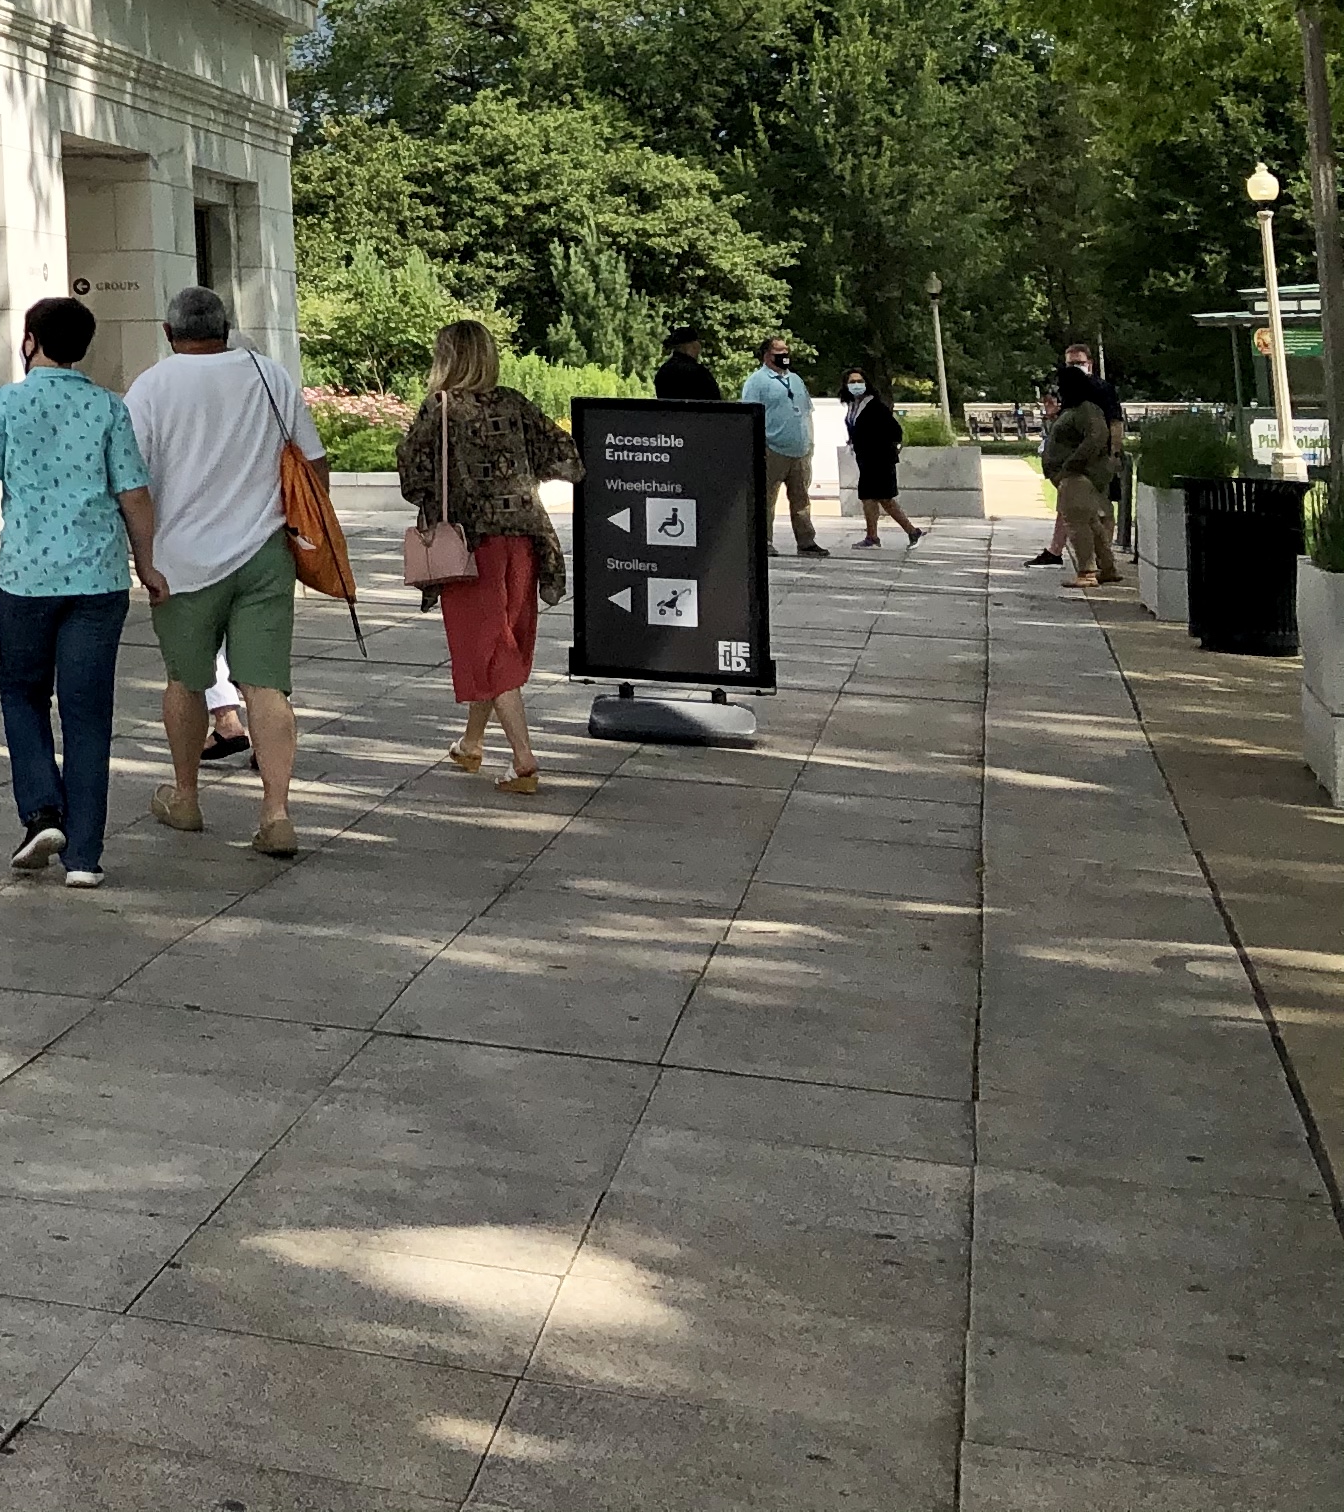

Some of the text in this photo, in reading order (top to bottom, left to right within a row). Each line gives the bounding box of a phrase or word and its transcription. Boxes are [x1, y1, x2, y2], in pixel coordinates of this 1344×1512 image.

[95, 281, 140, 291] GROUPS
[605, 433, 684, 448] Accessible
[605, 448, 670, 463] Entrance
[605, 479, 682, 493] Wheelchairs
[606, 558, 658, 572] Strollers
